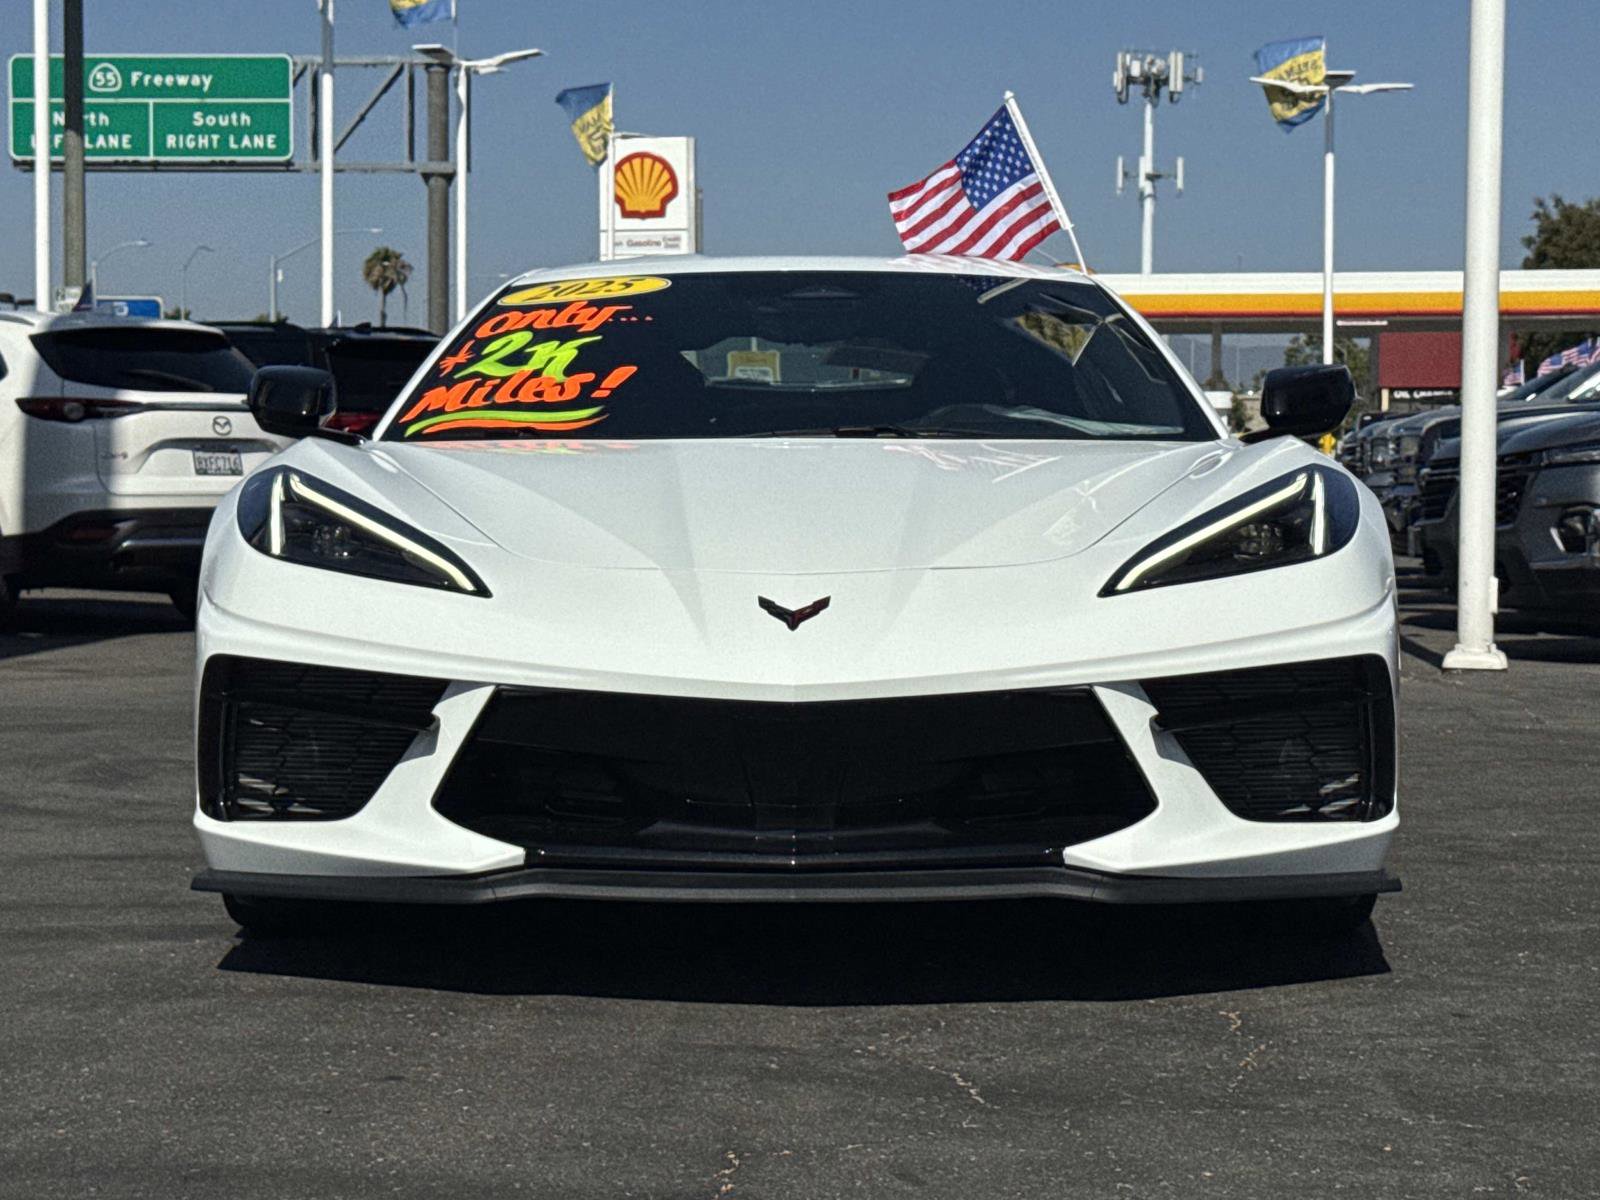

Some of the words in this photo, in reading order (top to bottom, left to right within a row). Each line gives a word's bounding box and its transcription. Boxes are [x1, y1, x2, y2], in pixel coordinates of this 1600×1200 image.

[95, 70, 117, 86] 55
[131, 71, 213, 92] Freeway
[53, 112, 110, 126] Nth
[192, 112, 251, 126] South
[84, 134, 132, 149] LANE
[166, 134, 220, 149] RIGHT
[229, 134, 277, 149] LANE
[522, 278, 647, 302] 2025
